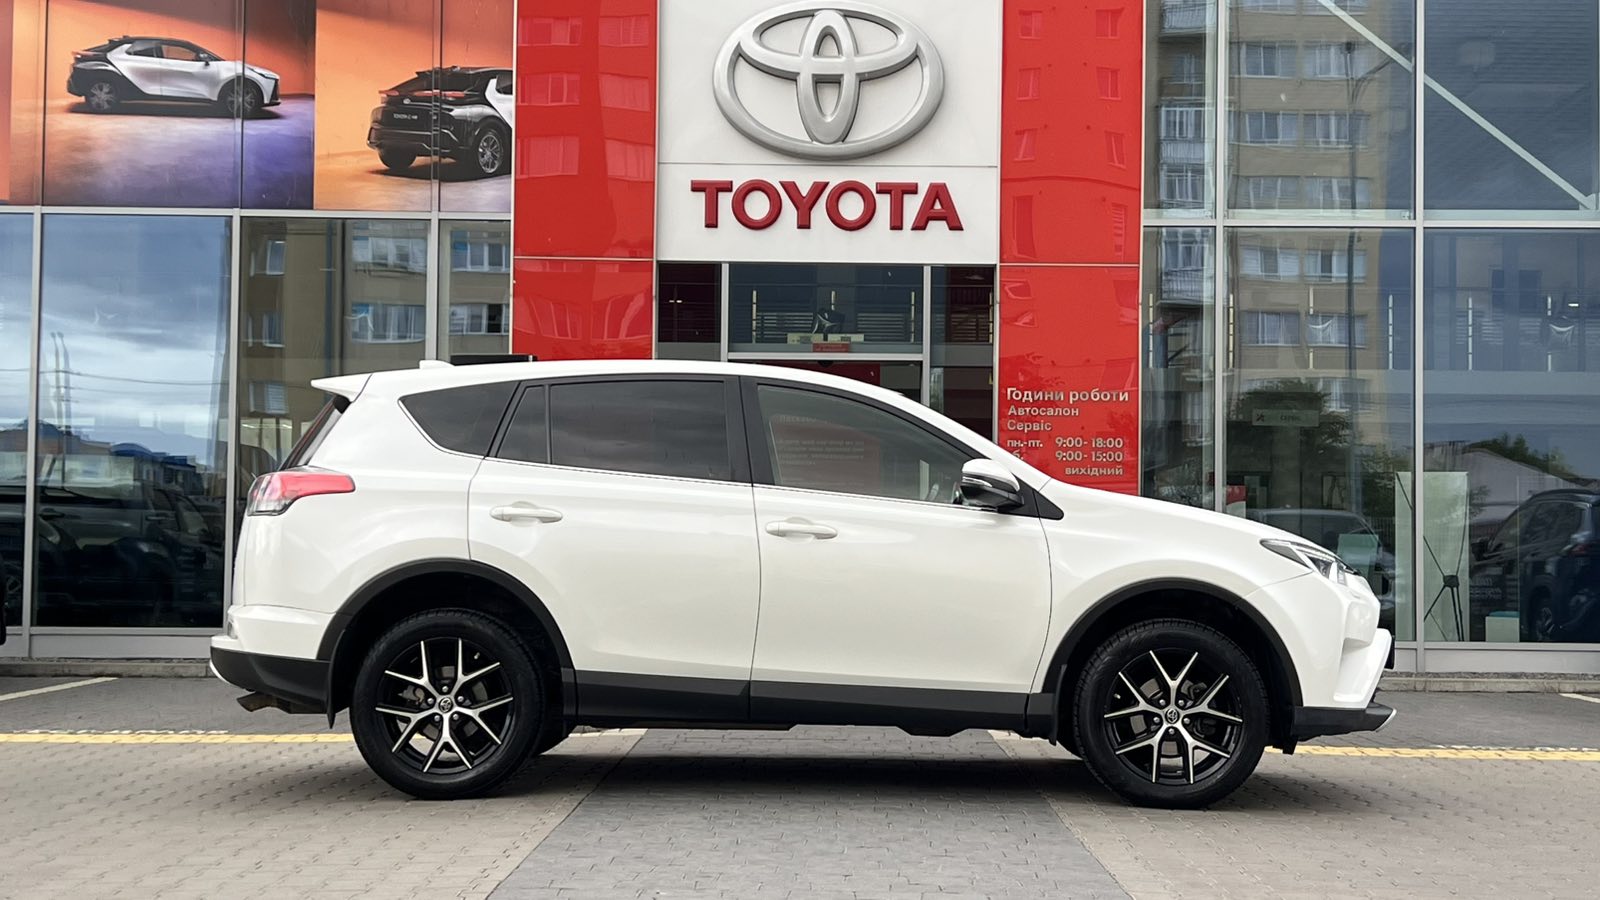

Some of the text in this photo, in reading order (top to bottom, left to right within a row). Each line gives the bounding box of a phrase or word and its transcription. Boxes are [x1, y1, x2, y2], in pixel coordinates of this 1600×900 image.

[690, 179, 964, 231] TOYOTA
[1007, 387, 1129, 404] Години роботи
[1008, 405, 1079, 416] Автосалон
[1007, 420, 1052, 433] Сервіс
[1091, 437, 1123, 448] 18:00
[1091, 451, 1123, 462] 15:00
[1065, 465, 1123, 476] вихідний
